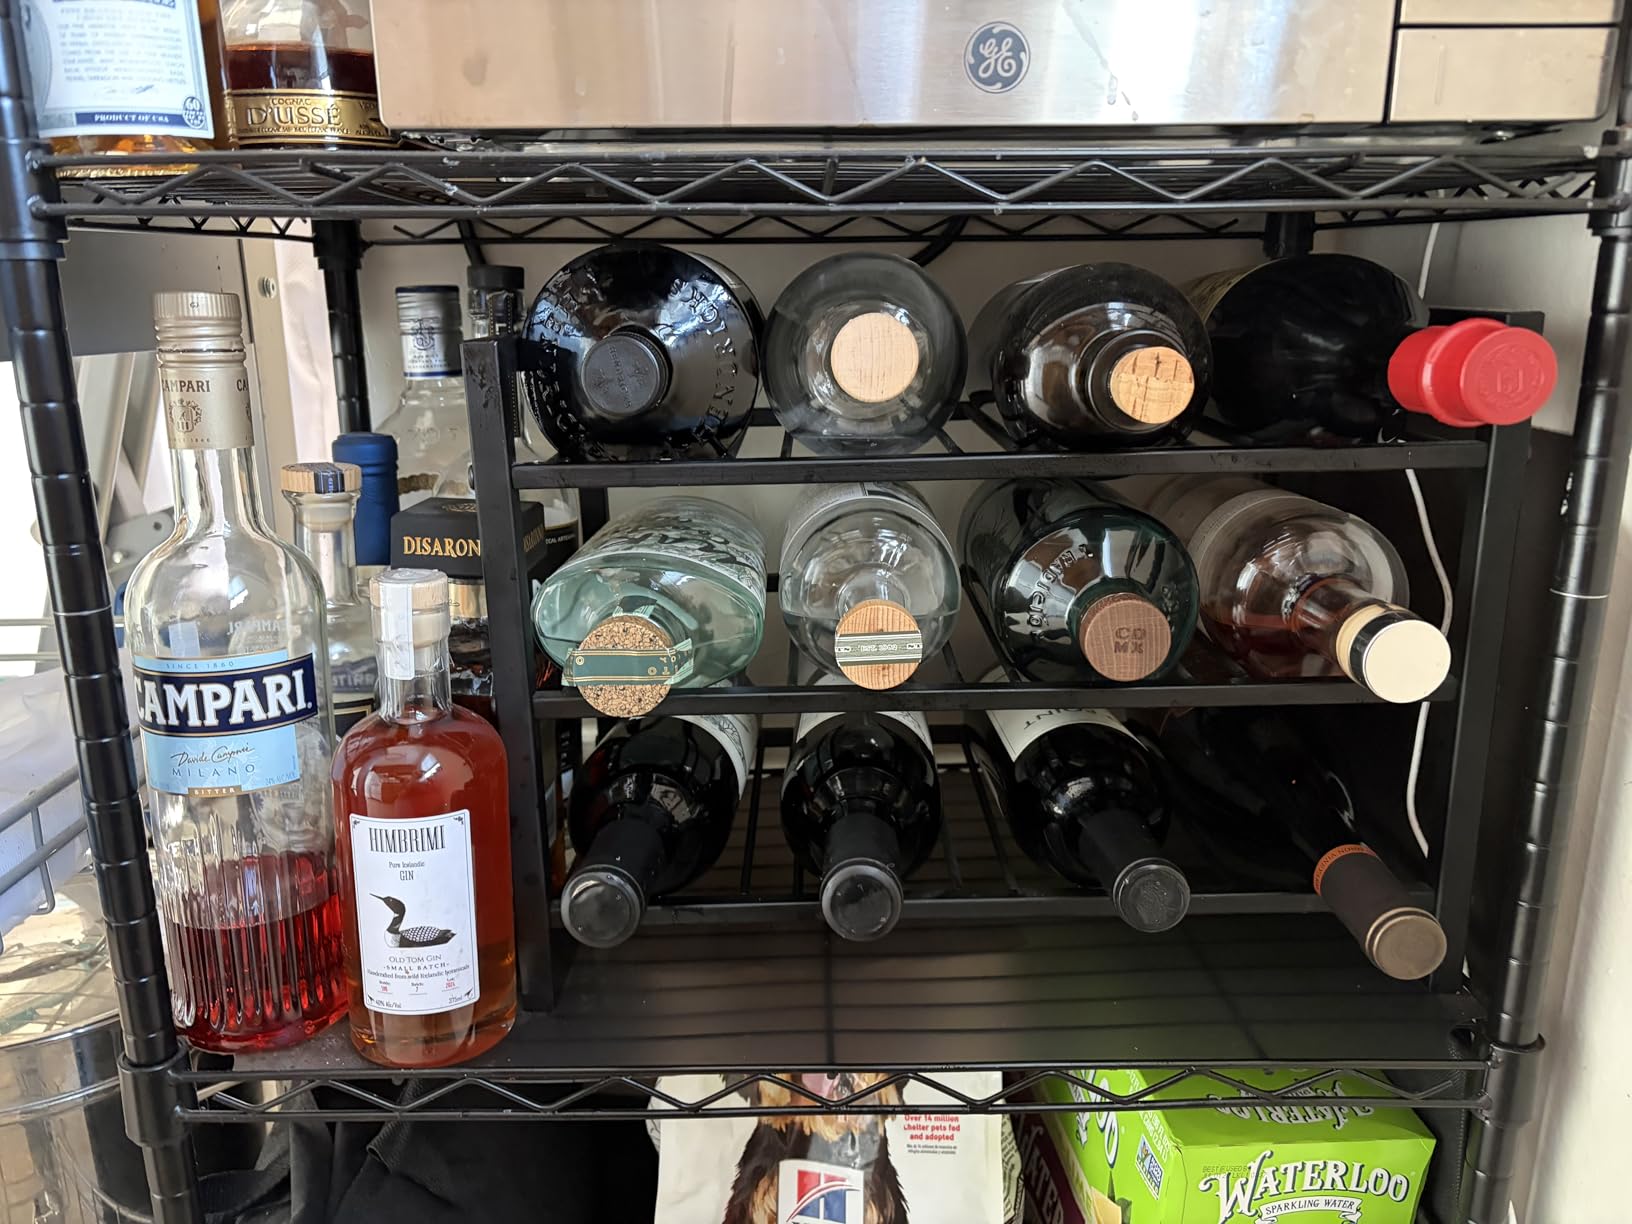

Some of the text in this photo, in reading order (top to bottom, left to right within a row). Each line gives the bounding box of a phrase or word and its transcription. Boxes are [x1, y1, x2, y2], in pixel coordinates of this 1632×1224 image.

[271, 97, 311, 107] COGNAC
[93, 113, 169, 123] PRODUCT OF USA
[402, 534, 480, 558] DISARON
[166, 660, 235, 671] SINCE 1860
[170, 751, 211, 767] Davide
[172, 763, 256, 778] MILANO
[194, 787, 236, 796] BITTER
[368, 823, 447, 854] HIMBRIMI
[388, 860, 425, 869] Pure Icelandic
[399, 870, 415, 882] GIN
[388, 953, 442, 964] OLD TOM GIN
[904, 1113, 921, 1122] Over
[933, 1113, 960, 1122] million
[930, 1123, 947, 1132] pets
[948, 1123, 961, 1132] fed
[909, 1132, 955, 1142] and adopted
[1198, 1150, 1410, 1224] WATERLOO
[1264, 1197, 1356, 1216] SPARKLING WATER
